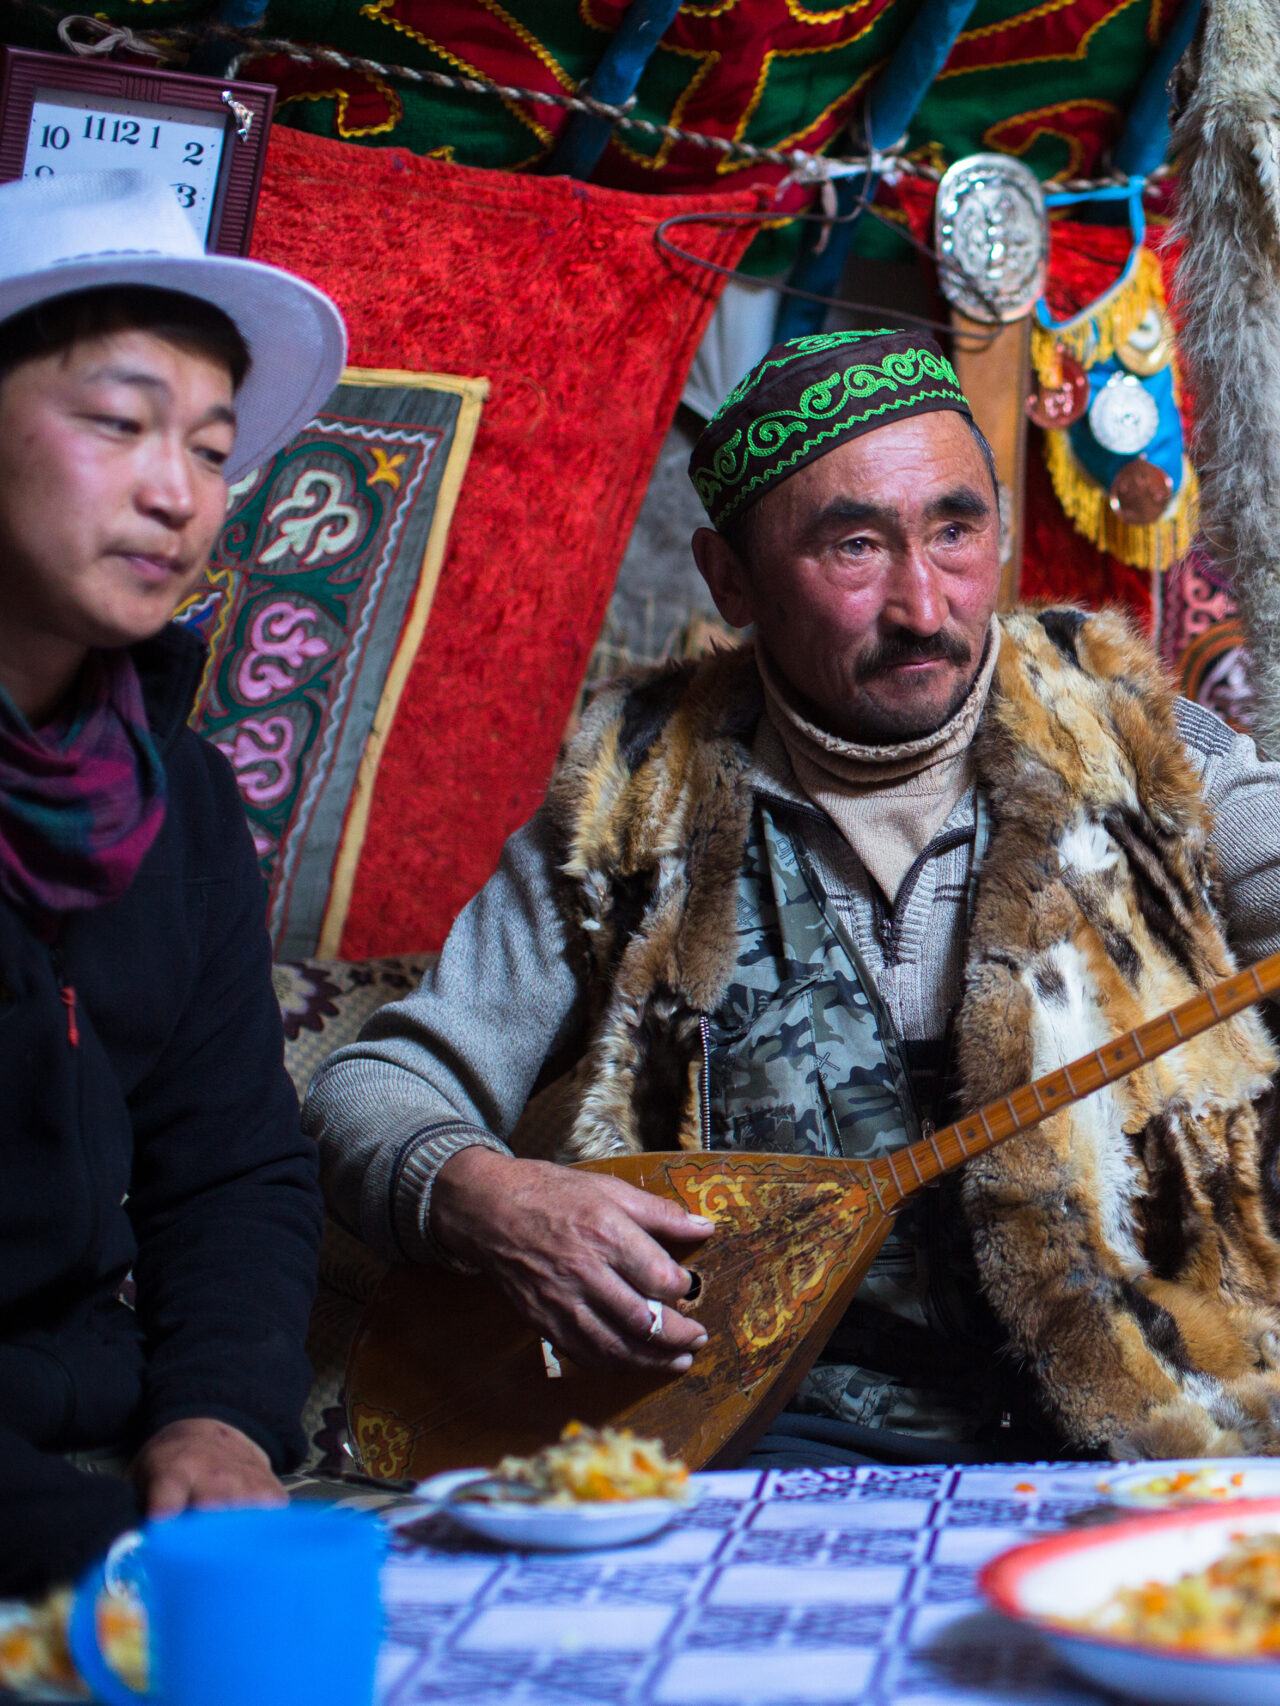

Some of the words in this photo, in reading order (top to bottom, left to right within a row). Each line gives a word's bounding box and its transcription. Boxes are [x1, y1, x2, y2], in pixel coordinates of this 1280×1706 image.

[40, 124, 70, 149] 10
[83, 115, 105, 140] 11
[111, 120, 140, 144] 12
[150, 126, 160, 149] 1
[182, 143, 204, 165] 2
[177, 185, 197, 208] 3
